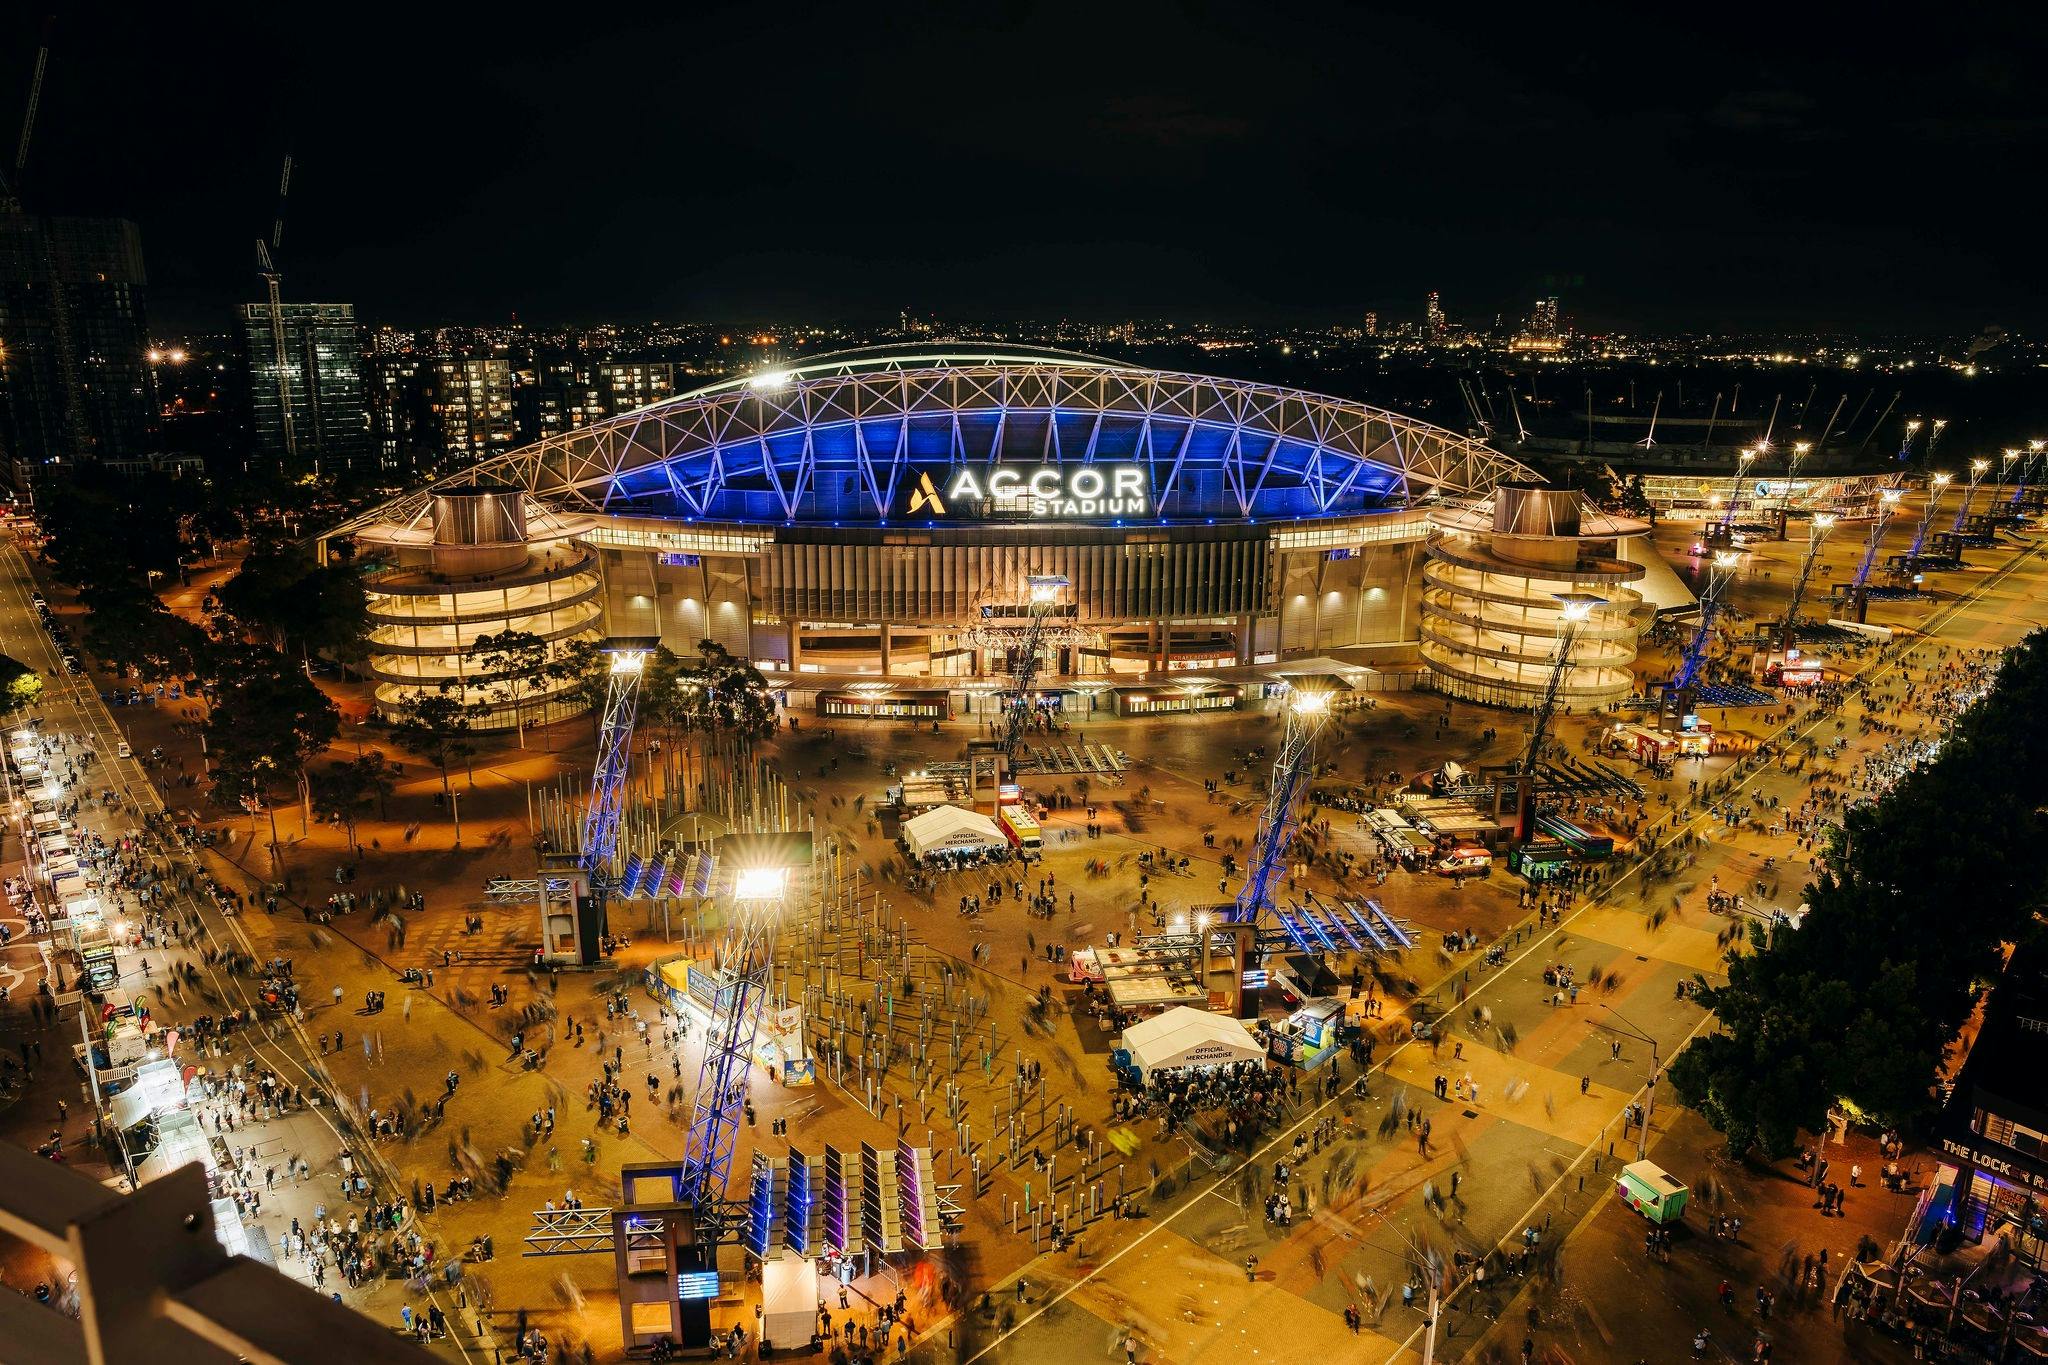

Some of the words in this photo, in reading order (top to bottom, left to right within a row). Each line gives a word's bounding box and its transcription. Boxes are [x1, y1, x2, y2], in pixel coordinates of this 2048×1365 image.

[950, 470, 1144, 499] ACCOR
[1033, 498, 1144, 515] STADIUM
[952, 832, 978, 840] OFFICIAL
[945, 838, 985, 846] MERCHANDISE
[588, 899, 594, 908] 2
[1255, 955, 1260, 963] 3
[1195, 1046, 1224, 1054] OFFICIAL
[1186, 1052, 1233, 1061] MERCHANDISE
[1943, 1139, 1970, 1159] THE
[697, 1251, 702, 1262] 1
